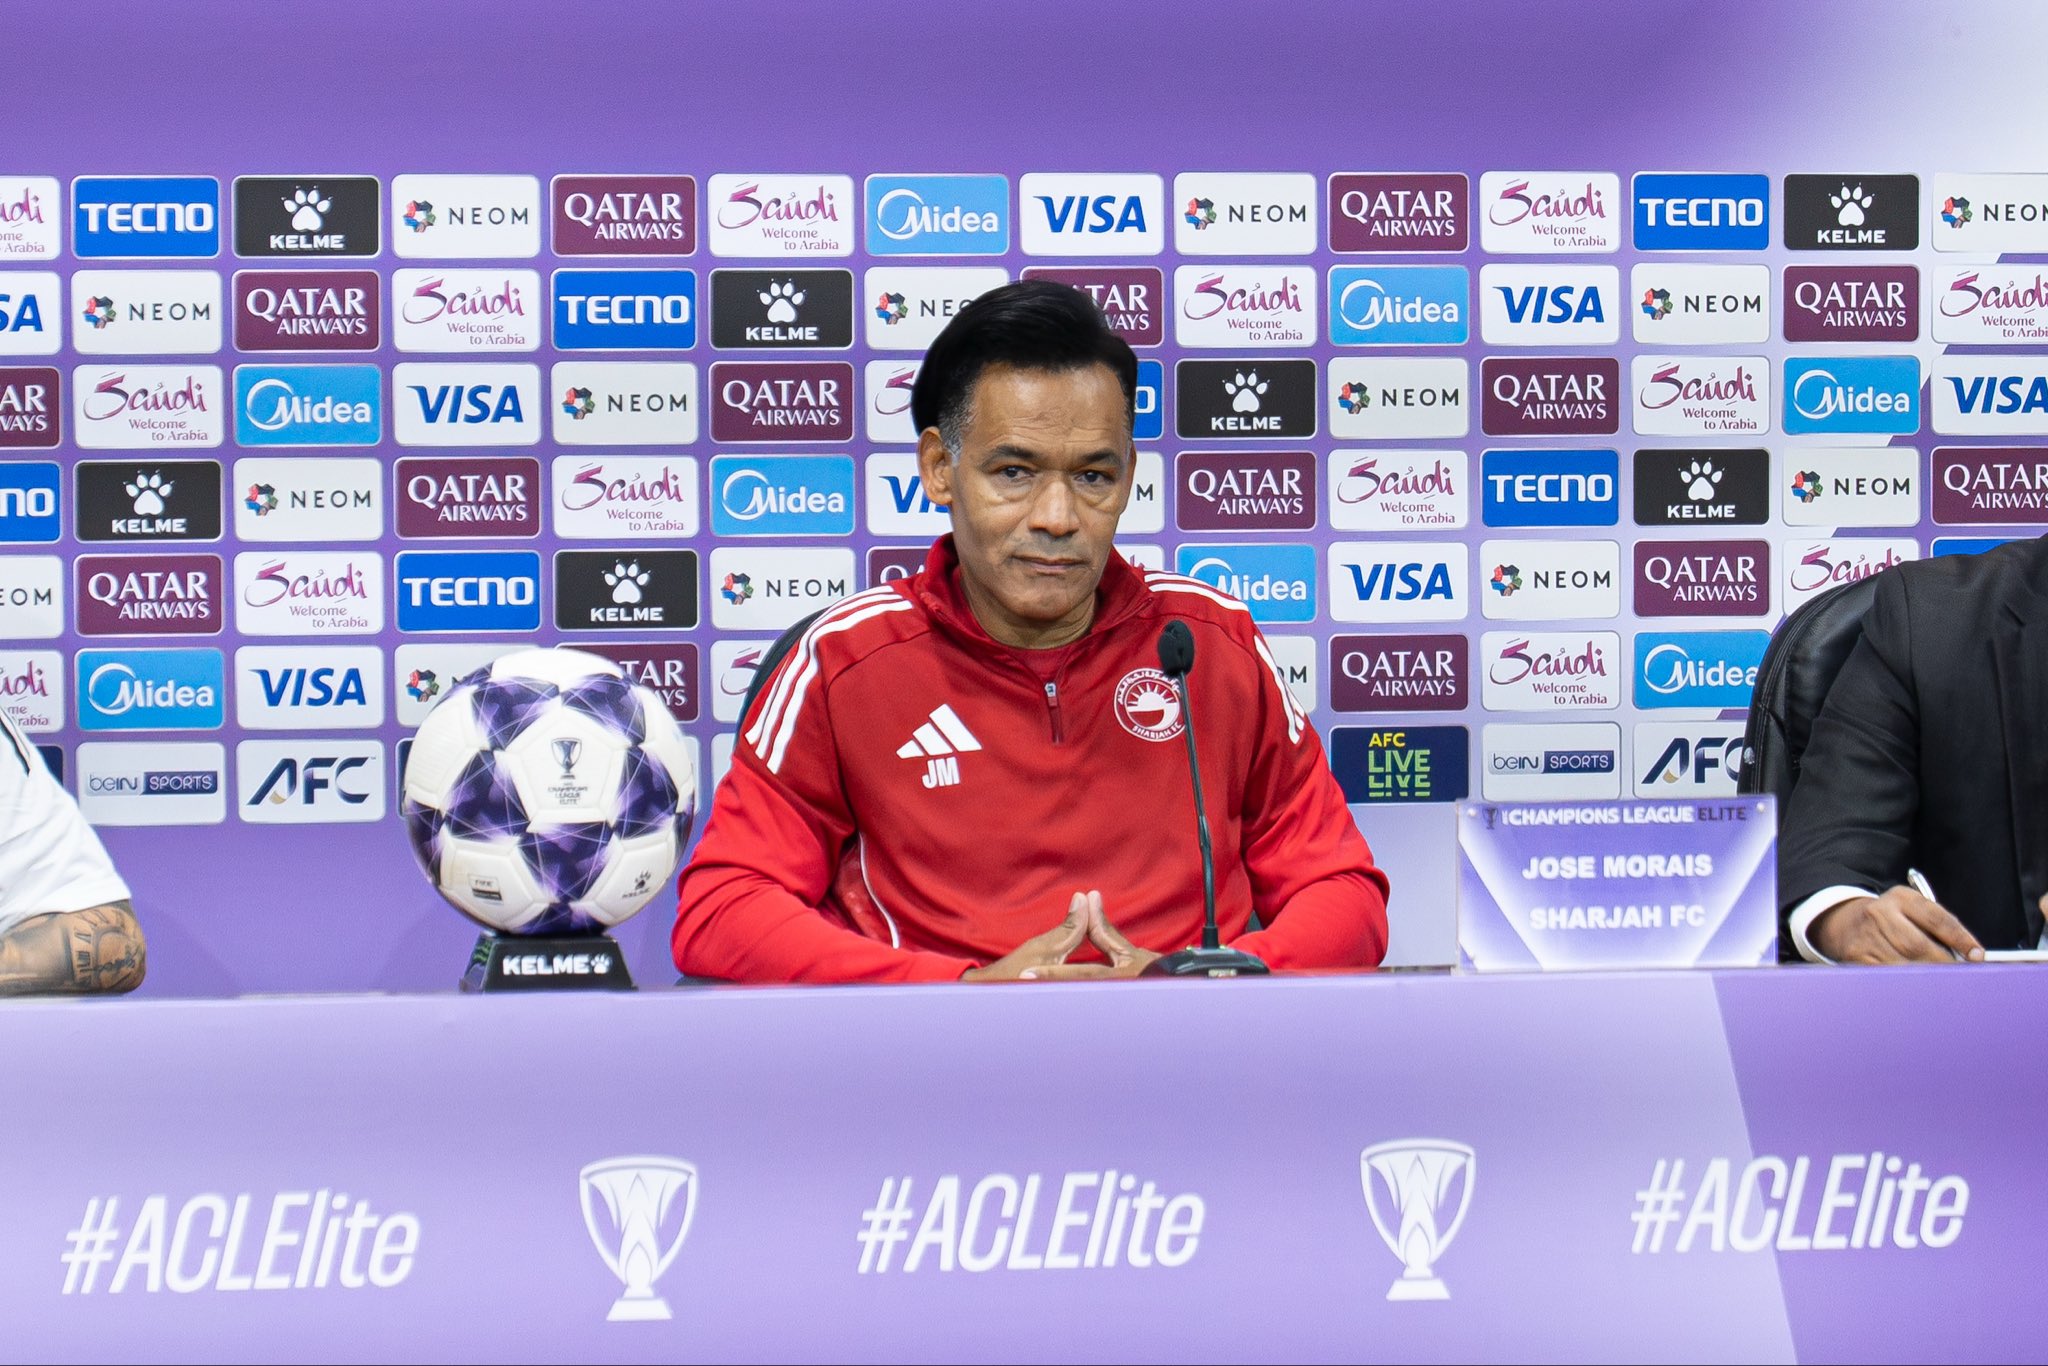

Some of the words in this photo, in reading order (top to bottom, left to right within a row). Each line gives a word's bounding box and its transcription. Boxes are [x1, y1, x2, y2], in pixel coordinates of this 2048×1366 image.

[448, 207, 528, 225] NEOM
[564, 192, 682, 227] QATAR
[1032, 195, 1147, 233] VISA
[1228, 204, 1306, 222] NEOM
[1340, 190, 1454, 224] QATAR
[1638, 198, 1763, 227] TECNO
[78, 203, 212, 232] TECNO
[892, 204, 998, 234] Midea
[594, 222, 682, 240] AIRWAYS
[762, 227, 818, 238] Welcome
[1369, 219, 1455, 236] AIRWAYS
[1532, 224, 1586, 234] Welcome
[1817, 229, 1885, 243] KELME
[269, 234, 343, 248] KELME
[783, 240, 796, 249] to
[799, 239, 839, 250] Arabia
[1553, 237, 1565, 246] to
[1568, 236, 1606, 246] Arabia
[246, 288, 365, 322] QATAR
[1073, 284, 1150, 311] TAR
[1491, 285, 1604, 323] VISA
[1684, 295, 1760, 312] NEOM
[1794, 281, 1906, 314] QATAR
[128, 303, 210, 320] NEOM
[558, 295, 689, 324] TECNO
[1354, 294, 1458, 324] Midea
[276, 317, 366, 335] AIRWAYS
[447, 322, 504, 332] Welcome
[1227, 318, 1282, 328] Welcome
[1822, 310, 1906, 327] AIRWAYS
[1982, 316, 2035, 326] Welcome
[469, 335, 482, 344] to
[485, 334, 525, 345] Arabia
[745, 326, 817, 340] KELME
[1248, 331, 1261, 340] to
[1264, 330, 1302, 340] Arabia
[2002, 328, 2014, 337] to
[2017, 327, 2048, 338] Arabi
[722, 379, 839, 413] QATAR
[1381, 388, 1458, 406] NEOM
[1493, 374, 1606, 407] QATAR
[1808, 384, 1909, 414] Midea
[1943, 376, 2048, 414] VISA
[261, 394, 370, 425] Midea
[406, 385, 523, 423] VISA
[607, 394, 686, 412] NEOM
[1521, 403, 1606, 420] AIRWAYS
[1682, 407, 1737, 417] Welcome
[128, 418, 186, 429] Welcome
[752, 408, 840, 426] AIRWAYS
[1211, 416, 1281, 429] KELME
[1704, 420, 1716, 429] to
[1719, 419, 1757, 429] Arabia
[151, 431, 164, 440] to
[167, 430, 208, 441] Arabia
[407, 475, 526, 509] QATAR
[1188, 468, 1302, 502] QATAR
[1487, 474, 1613, 502] TECNO
[1834, 477, 1909, 495] NEOM
[290, 490, 371, 508] NEOM
[737, 484, 844, 515] Midea
[1217, 497, 1303, 515] AIRWAYS
[1380, 501, 1434, 512] Welcome
[1971, 492, 2048, 509] AIRWAY
[437, 504, 526, 521] AIRWAYS
[606, 508, 663, 519] Welcome
[1401, 514, 1413, 523] to
[1416, 513, 1455, 523] Arabia
[1667, 504, 1735, 517] KELME
[111, 518, 185, 532] KELME
[628, 521, 641, 530] to
[644, 520, 684, 531] Arabia
[1533, 570, 1610, 588] NEOM
[1644, 556, 1756, 589] QATAR
[88, 571, 208, 606] QATAR
[402, 576, 534, 606] TECNO
[765, 579, 844, 596] NEOM
[1212, 573, 1306, 602] Midea
[1340, 563, 1453, 601] VISA
[1672, 584, 1757, 601] AIRWAYS
[118, 601, 208, 619] AIRWAYS
[289, 605, 346, 615] Welcome
[590, 607, 663, 621] KELME
[311, 618, 324, 627] to
[327, 617, 368, 627] Arabia
[618, 659, 686, 687] TAR
[1341, 650, 1455, 684] QATAR
[103, 677, 213, 709] Midea
[248, 667, 366, 706] VISA
[1370, 679, 1455, 696] AIRWAYS
[1532, 682, 1587, 693] Welcome
[1553, 695, 1566, 704] to
[1569, 694, 1607, 704] Arabia
[12, 715, 49, 726] rabia
[1368, 732, 1406, 747] AFC
[1368, 749, 1431, 773] LIVE
[1550, 754, 1609, 769] SPORTS
[246, 756, 371, 805] AFC
[922, 756, 961, 788] JM
[149, 775, 213, 790] SPORTS
[1509, 806, 1620, 826] CHAMPIONS
[1622, 806, 1696, 824] LEAGUE
[1699, 806, 1747, 821] ELITE
[1521, 856, 1596, 879] JOSE
[1603, 854, 1714, 878] MORAIS
[1529, 905, 1663, 930] SHARJAH
[1670, 904, 1706, 928] FC
[503, 954, 590, 975] KELME
[1630, 1151, 1970, 1254] #ACLElite
[856, 1168, 1206, 1274] #ACLElite
[60, 1188, 421, 1295] #ACLElite
